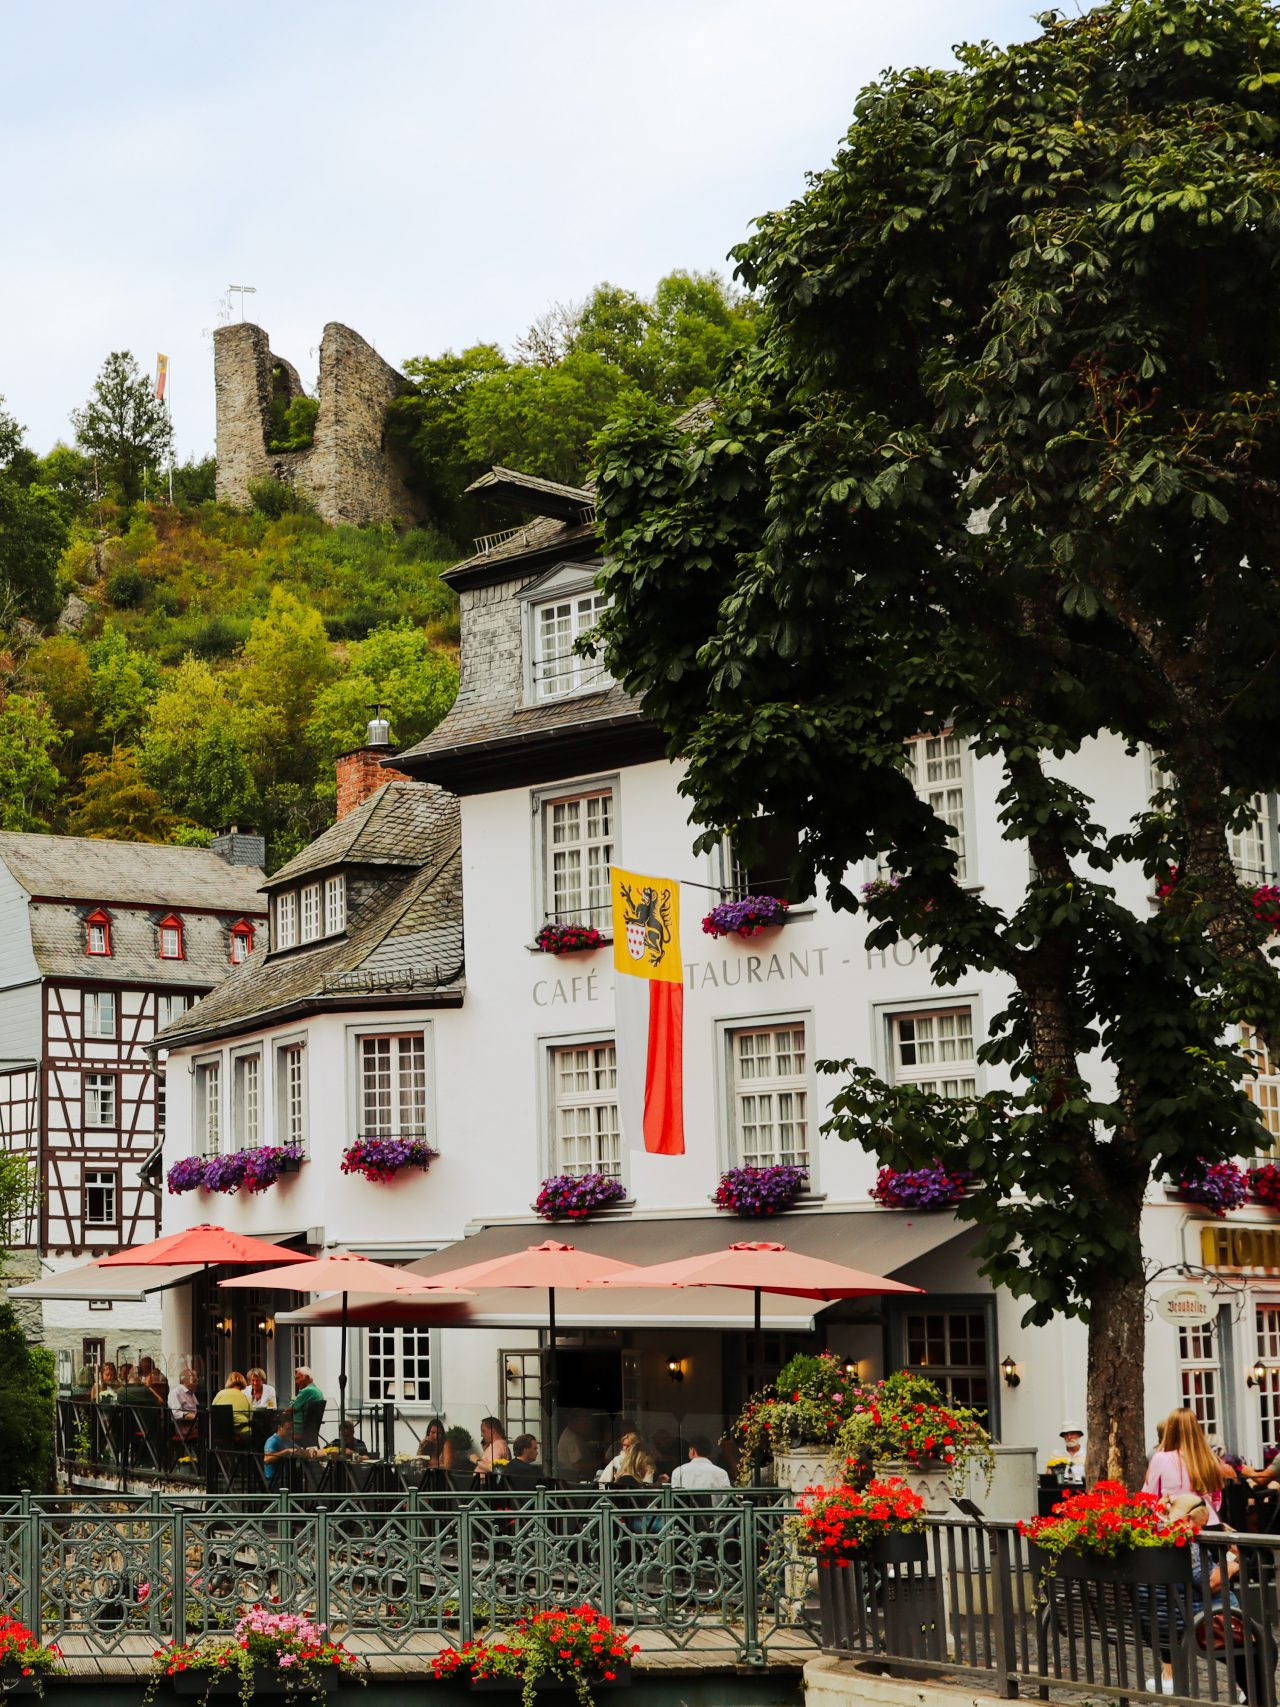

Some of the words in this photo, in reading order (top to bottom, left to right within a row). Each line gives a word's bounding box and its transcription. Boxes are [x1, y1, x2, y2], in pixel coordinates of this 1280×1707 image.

[532, 968, 598, 1007] CAFÉ
[684, 947, 829, 990] TAURANT
[1214, 1228, 1280, 1266] HOT
